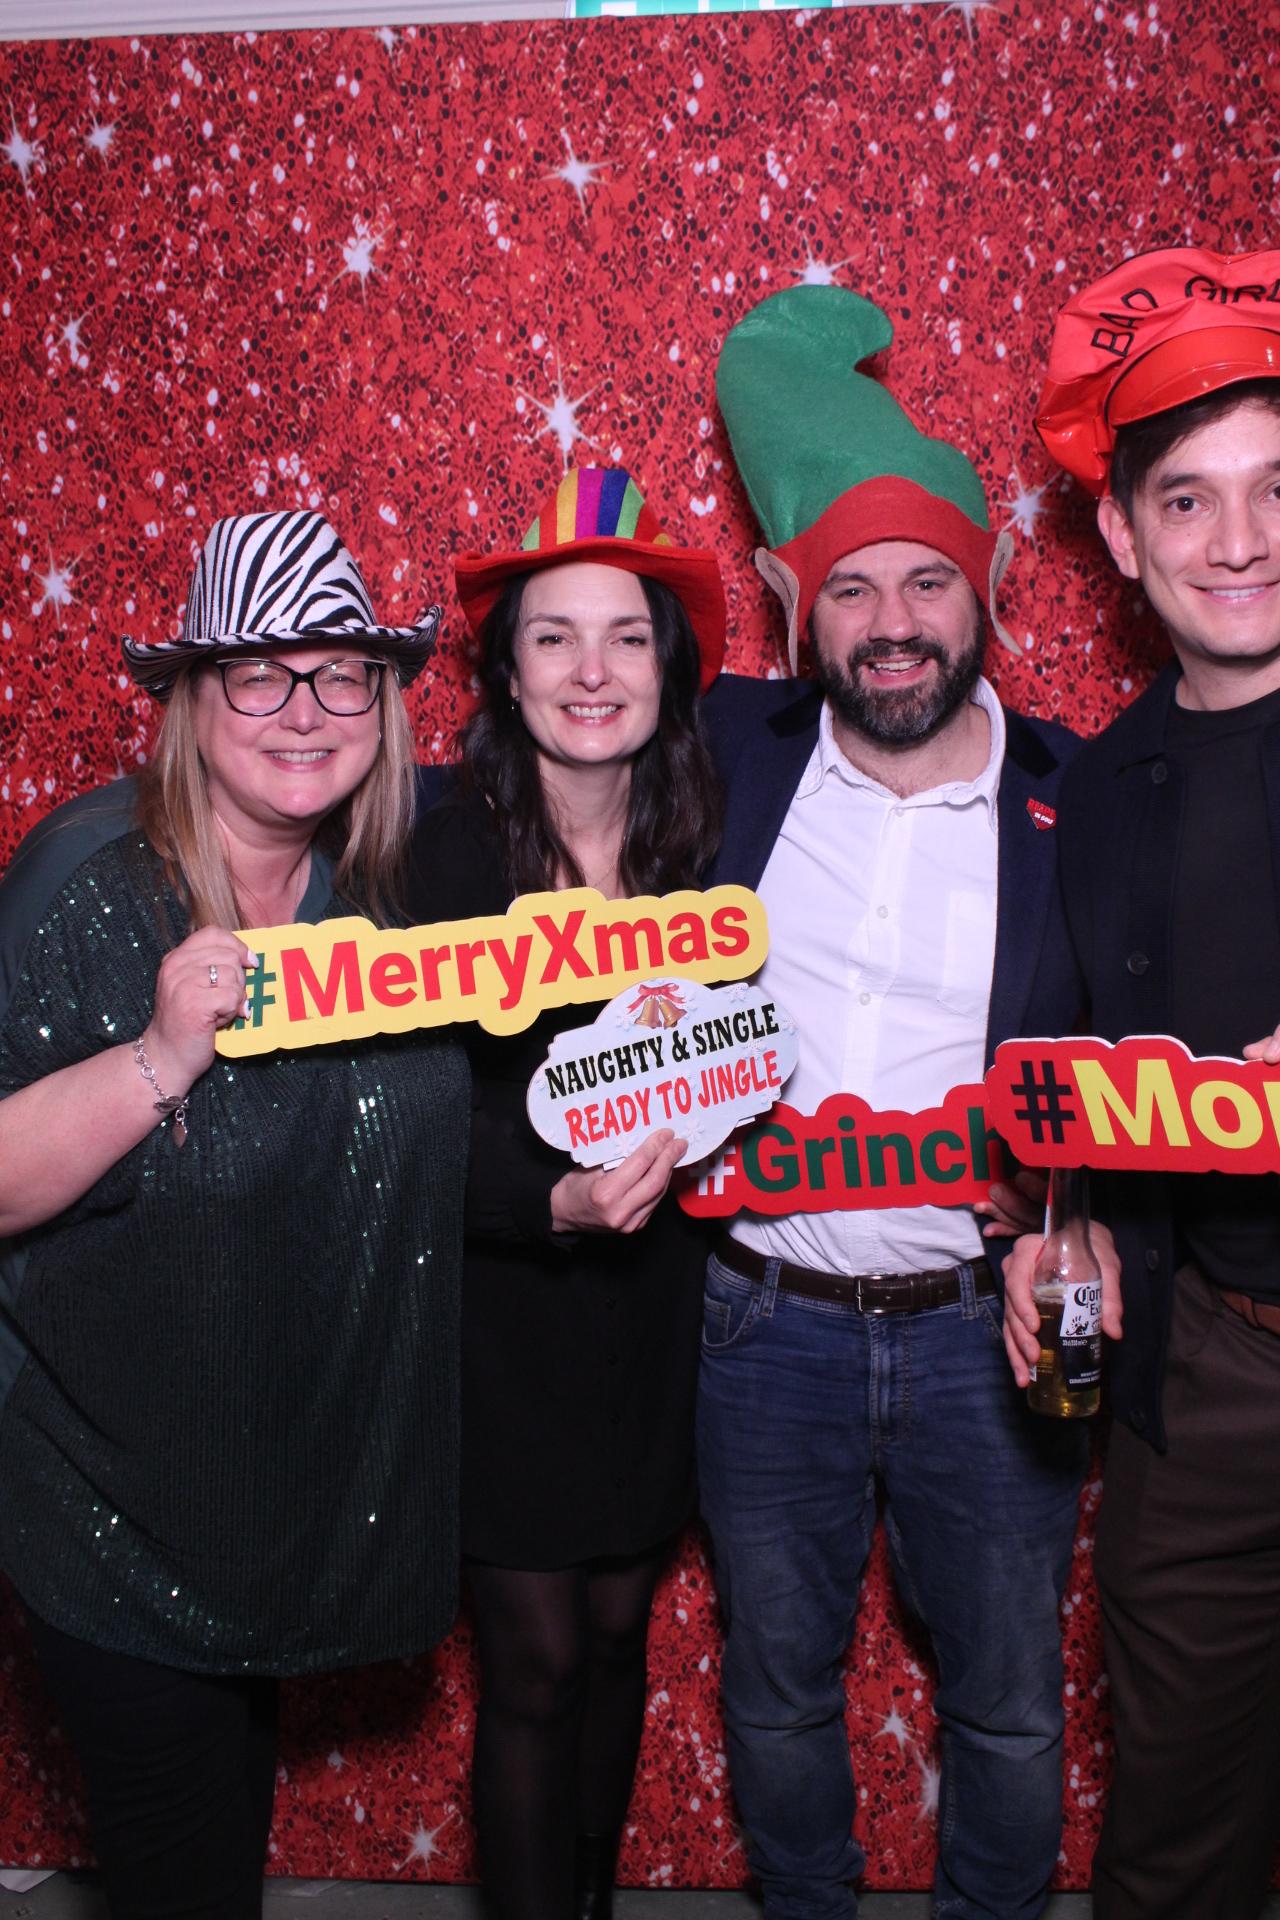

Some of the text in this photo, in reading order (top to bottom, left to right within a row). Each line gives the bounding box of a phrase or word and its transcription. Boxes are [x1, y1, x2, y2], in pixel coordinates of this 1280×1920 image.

[1090, 288, 1159, 359] BAD
[231, 906, 750, 1031] #MerryXmas
[545, 1002, 780, 1100] NAUGHTY & SINGLE
[564, 1050, 782, 1149] READY TO JINGLE
